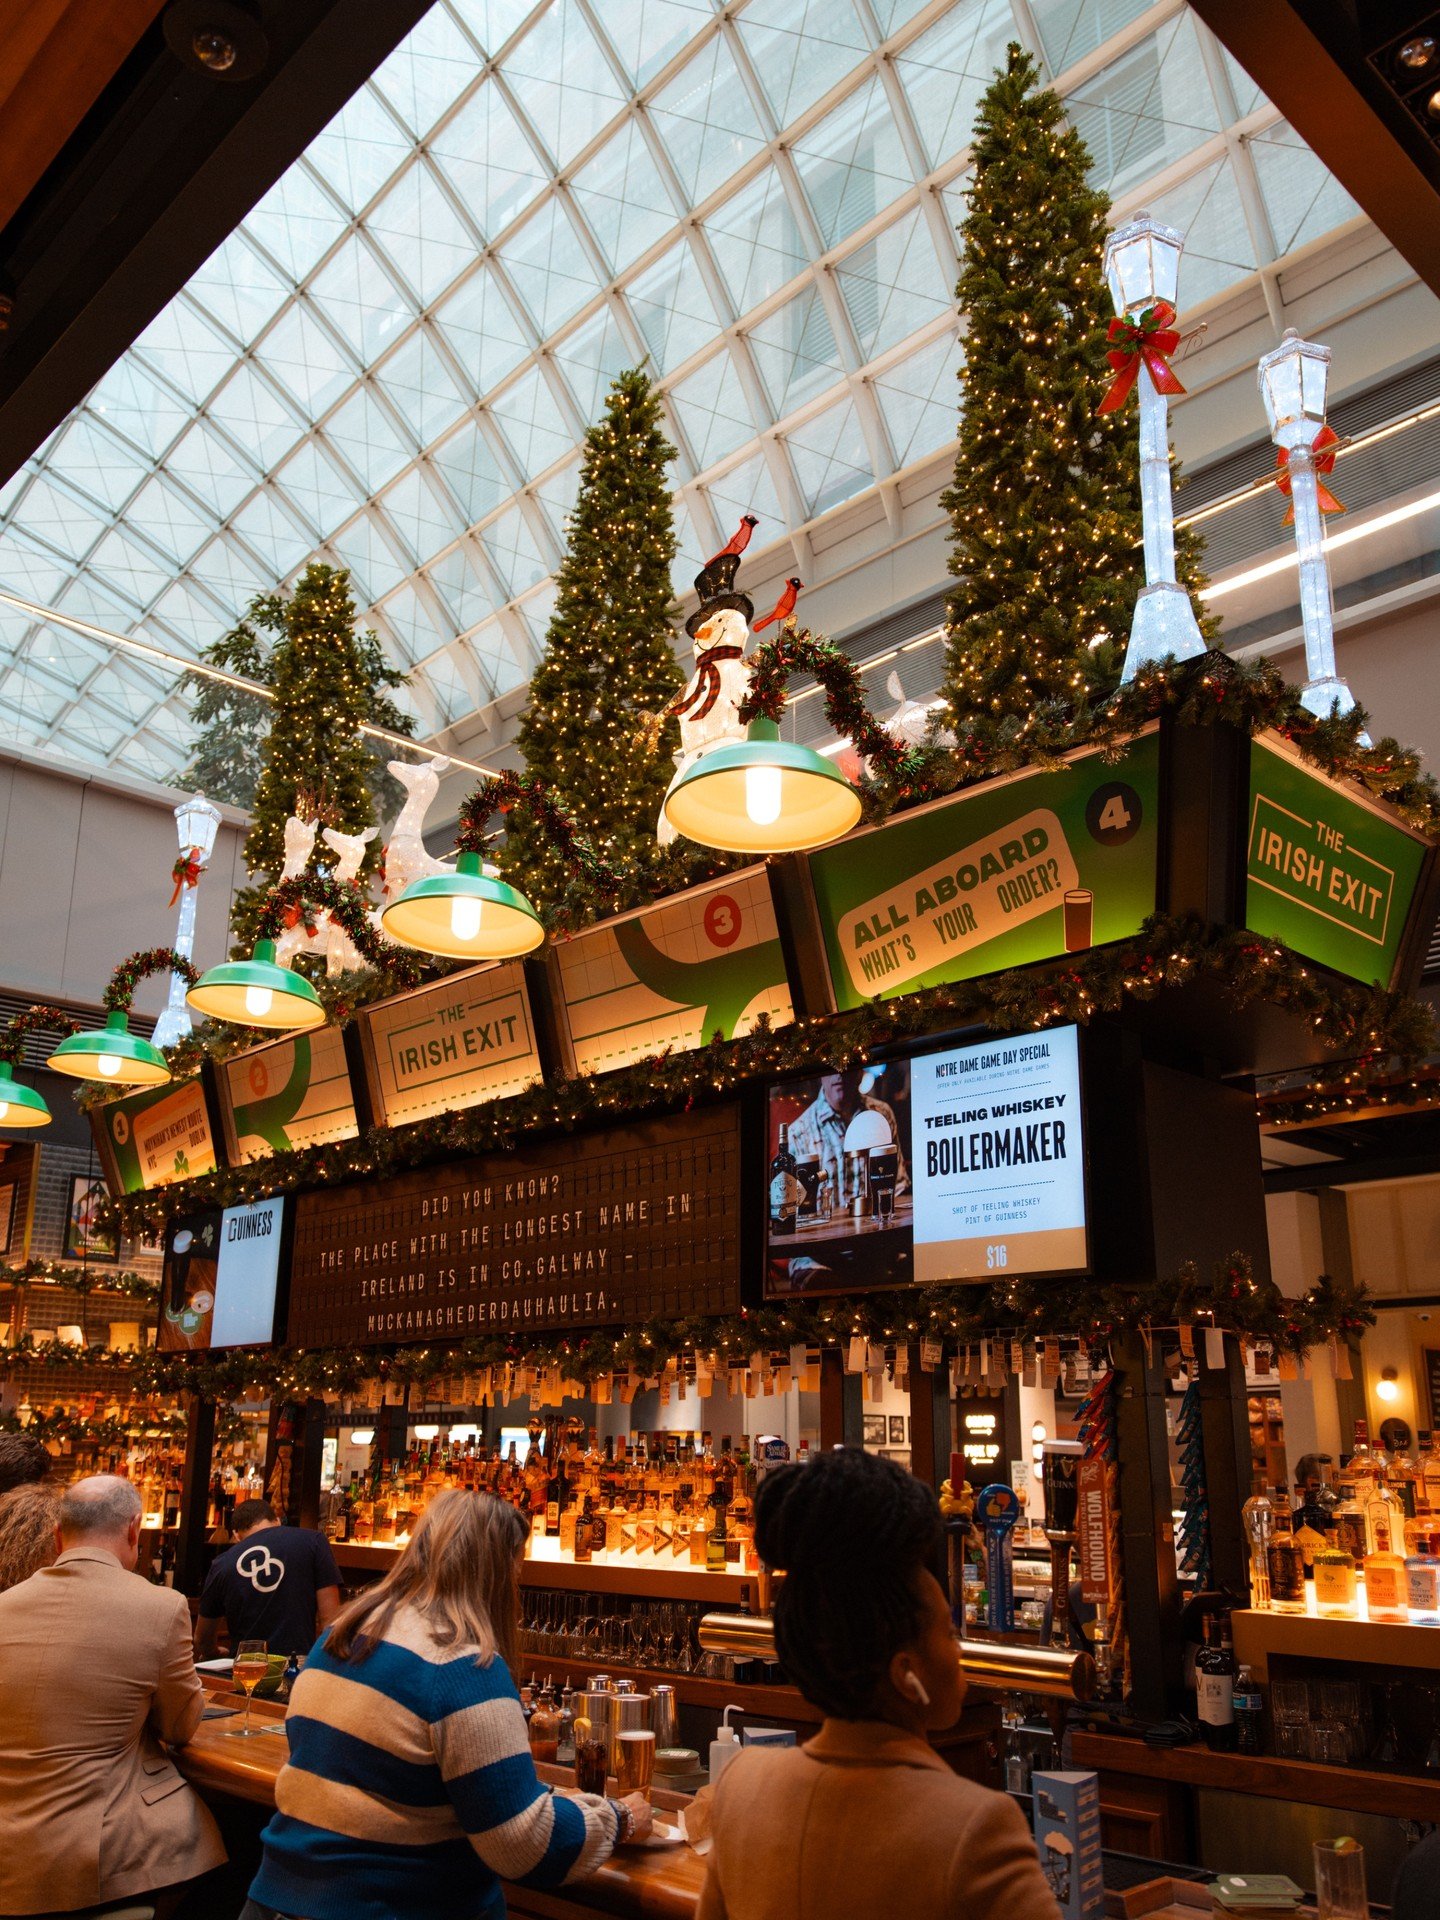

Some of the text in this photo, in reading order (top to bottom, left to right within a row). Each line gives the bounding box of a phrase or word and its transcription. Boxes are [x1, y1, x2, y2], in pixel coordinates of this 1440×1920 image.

[1099, 795, 1131, 831] 4
[1317, 820, 1344, 854] THE
[854, 827, 1049, 949] ALL ABOARD
[1257, 827, 1383, 920] IRISH EXIT
[714, 907, 735, 935] 3
[858, 857, 1062, 983] WHAT'S YOUR ORDER?
[437, 1004, 466, 1025] THE
[398, 1014, 517, 1075] IRISH EXIT
[936, 1043, 1050, 1078] NOTRE DAME GAME DAY SPECIAL
[254, 1068, 266, 1087] 2
[116, 1118, 125, 1137] 1
[169, 1117, 188, 1139] NEWEST
[186, 1108, 203, 1128] ROUTE
[924, 1094, 1066, 1129] TEELING WHISKEY
[188, 1126, 206, 1148] DUBLIN
[926, 1120, 1066, 1178] BOILERMAKER
[422, 1174, 559, 1216] DID YOU KNOW?
[952, 1197, 1041, 1214] SHOT OF TEELING WHISKEY
[228, 1210, 273, 1242] GUINNESS
[320, 1193, 690, 1268] THE PLACE WITH THE LONGEST NAME IN
[966, 1210, 1028, 1224] PINT OF GUINNESS
[987, 1244, 1007, 1268] $16
[361, 1273, 425, 1297] IRELAND
[438, 1268, 456, 1288] IS
[470, 1264, 488, 1284] IN
[1086, 1490, 1106, 1582] WOLFHOUND
[1056, 1558, 1068, 1608] GUINNESS
